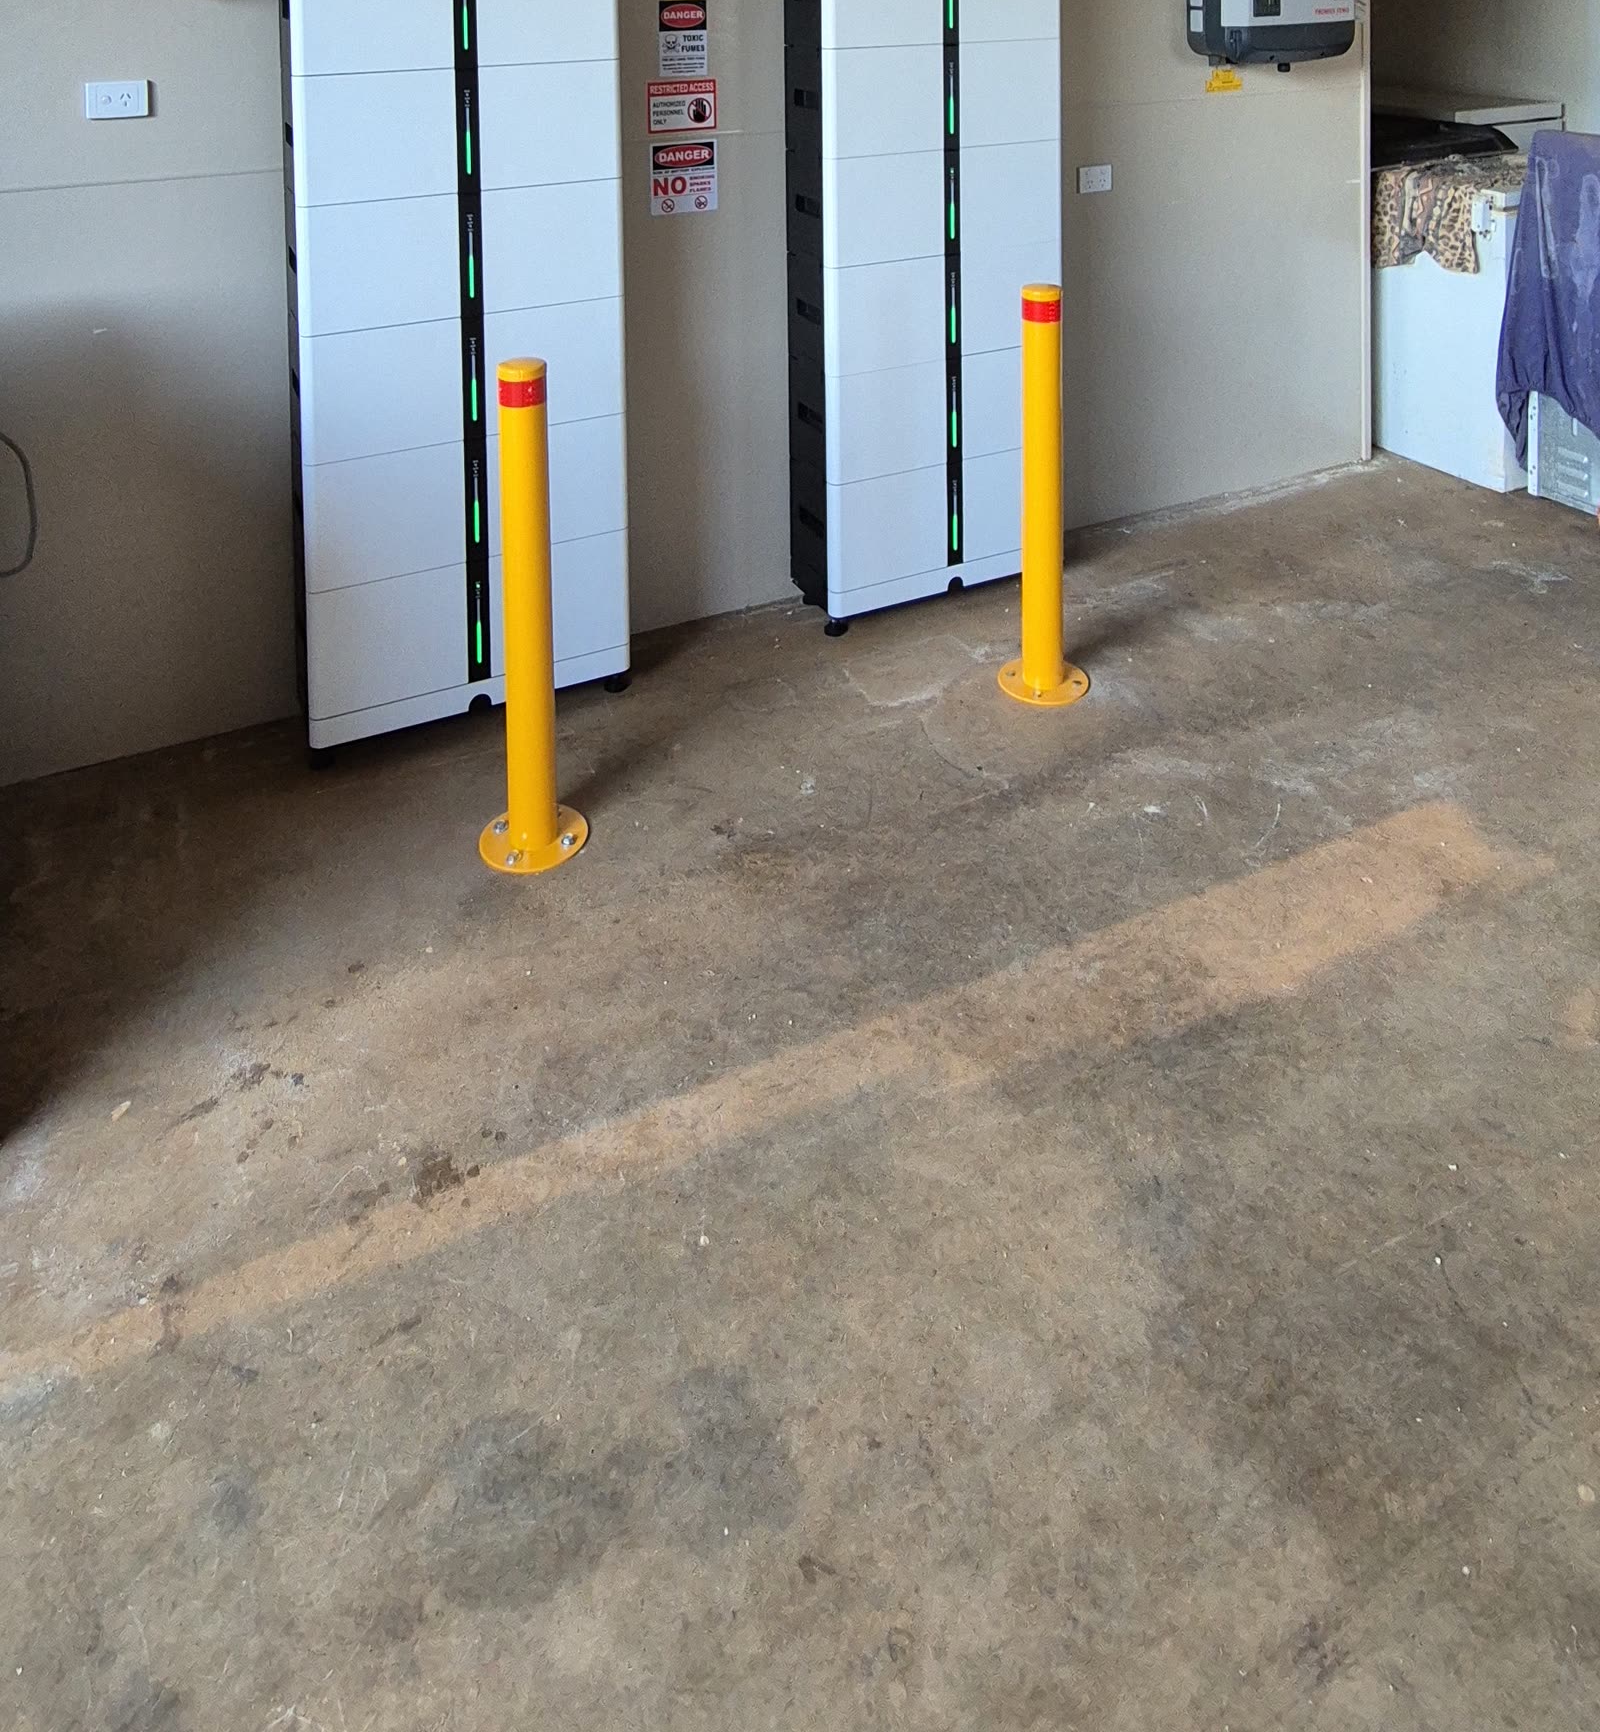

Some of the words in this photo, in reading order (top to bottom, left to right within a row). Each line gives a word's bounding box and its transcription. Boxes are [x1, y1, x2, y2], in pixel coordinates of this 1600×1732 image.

[663, 11, 703, 19] DANGER
[683, 34, 704, 42] TOXIC
[681, 44, 705, 52] FUMES
[650, 83, 689, 95] RESTRICTED
[689, 81, 714, 92] ACCESS
[659, 149, 710, 163] DANGER
[653, 176, 687, 197] NO
